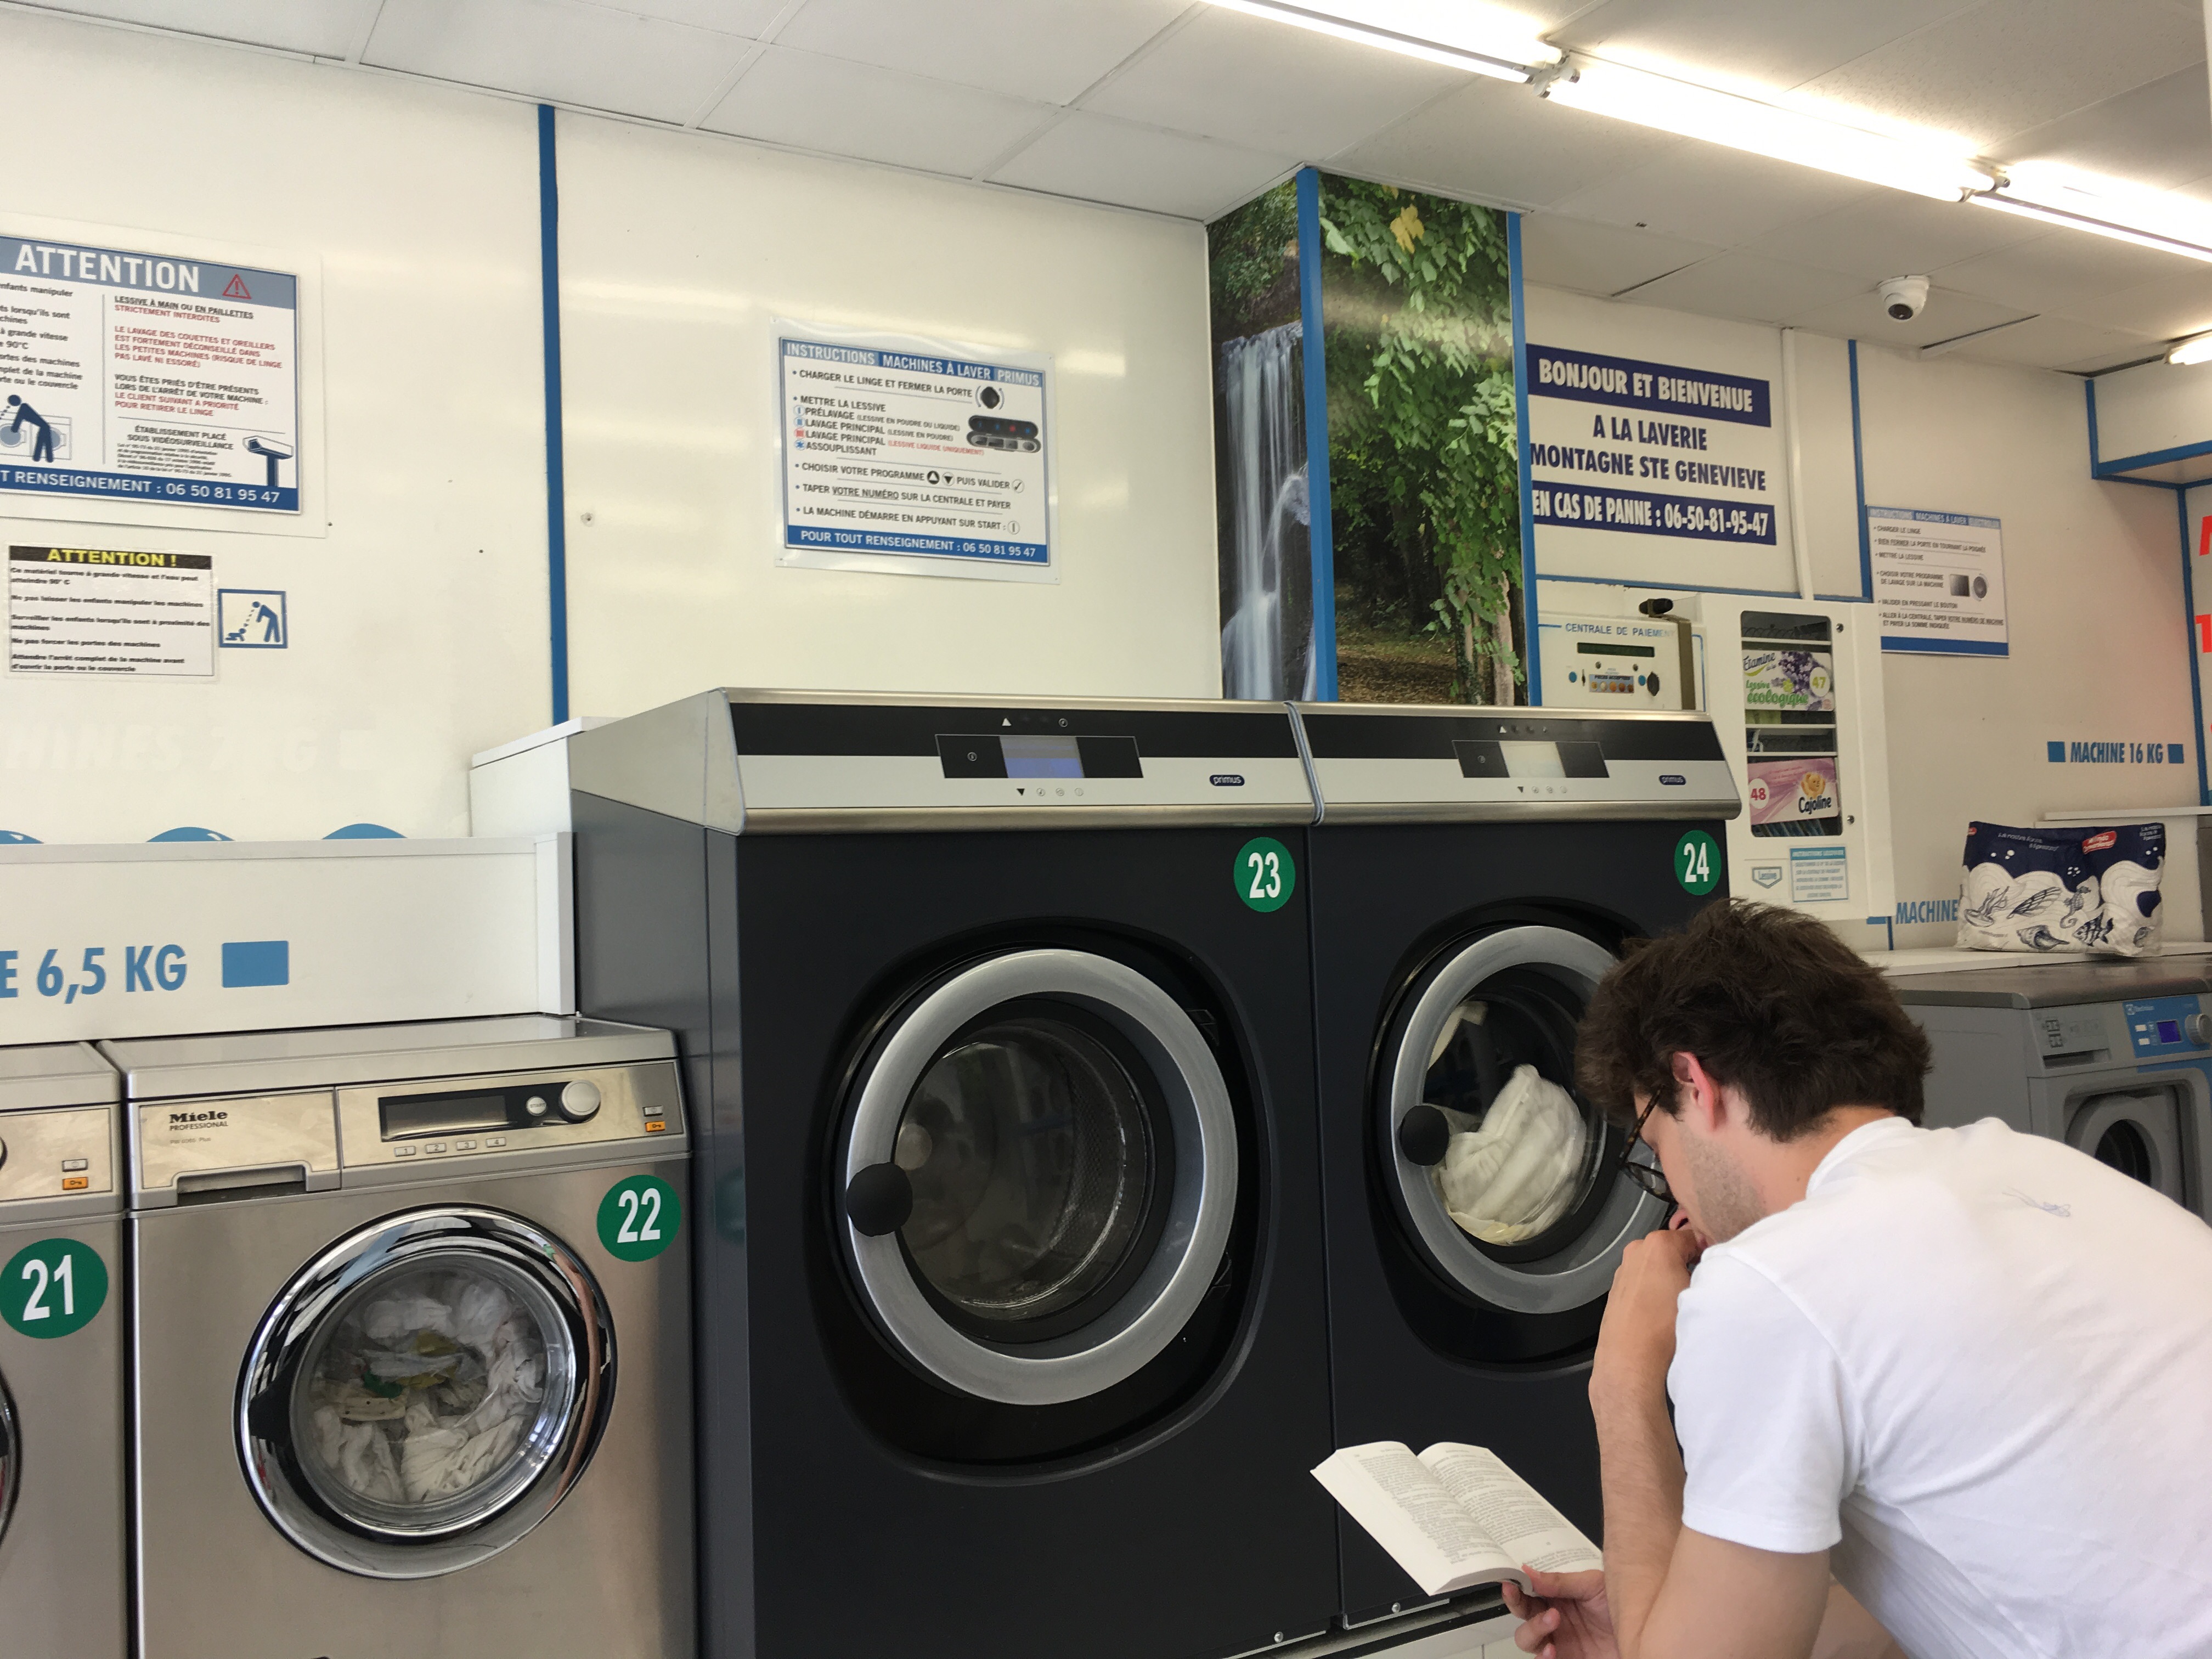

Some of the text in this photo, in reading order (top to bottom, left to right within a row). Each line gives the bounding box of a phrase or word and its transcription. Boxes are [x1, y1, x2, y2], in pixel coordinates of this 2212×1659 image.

[15, 245, 199, 292] ATTENTION
[114, 296, 149, 307] LESSIVE
[148, 298, 157, 308] À
[156, 301, 179, 310] MAIN
[195, 305, 207, 314] EN
[207, 307, 254, 319] PAILLETTES
[114, 304, 221, 323] STRICTEMENT INTERDITES
[787, 342, 1039, 386] INSTRUCTIONS MACHINES À LAVER PRIMUS
[799, 369, 973, 398] CHARGER LE LINGE ET FERMER LA PORTE
[1539, 359, 1753, 412] BONJOUR ET BIENVENUE
[800, 395, 886, 412] METTRE LA LESSIVE
[1593, 414, 1707, 450] A LA LAVERIE
[806, 442, 877, 456] ASSOUPLISSANT
[802, 462, 1010, 489] CHOISIR VOTRE PROGRAMME PUIS VALIDER
[1531, 443, 1766, 491] MONTAGNE STE GENEVIEVE
[15, 471, 152, 492] RENSEIGNEMENT
[166, 483, 186, 495] 06
[190, 485, 210, 497] 50
[214, 487, 233, 499] 81
[238, 489, 257, 501] 95
[261, 491, 280, 503] 47
[802, 483, 1011, 509] TAPER VOTRE NUMÉRO SUR LA CENTRALE ET PAYER
[803, 506, 1002, 530] LA MACHINE DÉMARRE EN APPUYANT SUR START
[1531, 489, 1551, 516] EN
[1554, 492, 1581, 520] CAS
[1584, 495, 1602, 521] DE
[1605, 498, 1652, 526] PANNE
[1664, 504, 1769, 536] 06-50-81-95-47
[801, 531, 832, 542] POUR
[834, 533, 863, 544] TOUT
[865, 535, 955, 550] RENSEIGNEMENT
[963, 542, 976, 552] 06
[979, 544, 991, 554] 50
[994, 545, 1006, 555] 81
[1008, 546, 1021, 556] 95
[1023, 548, 1036, 557] 47
[47, 549, 176, 567] ATTENTION !
[1565, 623, 1612, 634] CENTRALE
[1616, 627, 1628, 635] DE
[1812, 676, 1826, 689] 47
[1747, 689, 1808, 708] écologique
[2070, 742, 2163, 764] MACHINE 16 KG
[1213, 776, 1242, 785] primus
[1662, 776, 1684, 784] primus
[1751, 788, 1766, 800] 48
[1798, 795, 1832, 815] Cajoline
[1684, 842, 1709, 883] 24
[1248, 852, 1281, 899] 23
[1896, 900, 1958, 924] MACHINE
[37, 947, 106, 1004] 6,5
[125, 945, 188, 993] KG
[169, 1111, 228, 1123] Miele
[170, 1121, 228, 1131] PROFESSIONAL
[617, 1188, 661, 1244] 22
[21, 1254, 74, 1322] 21
